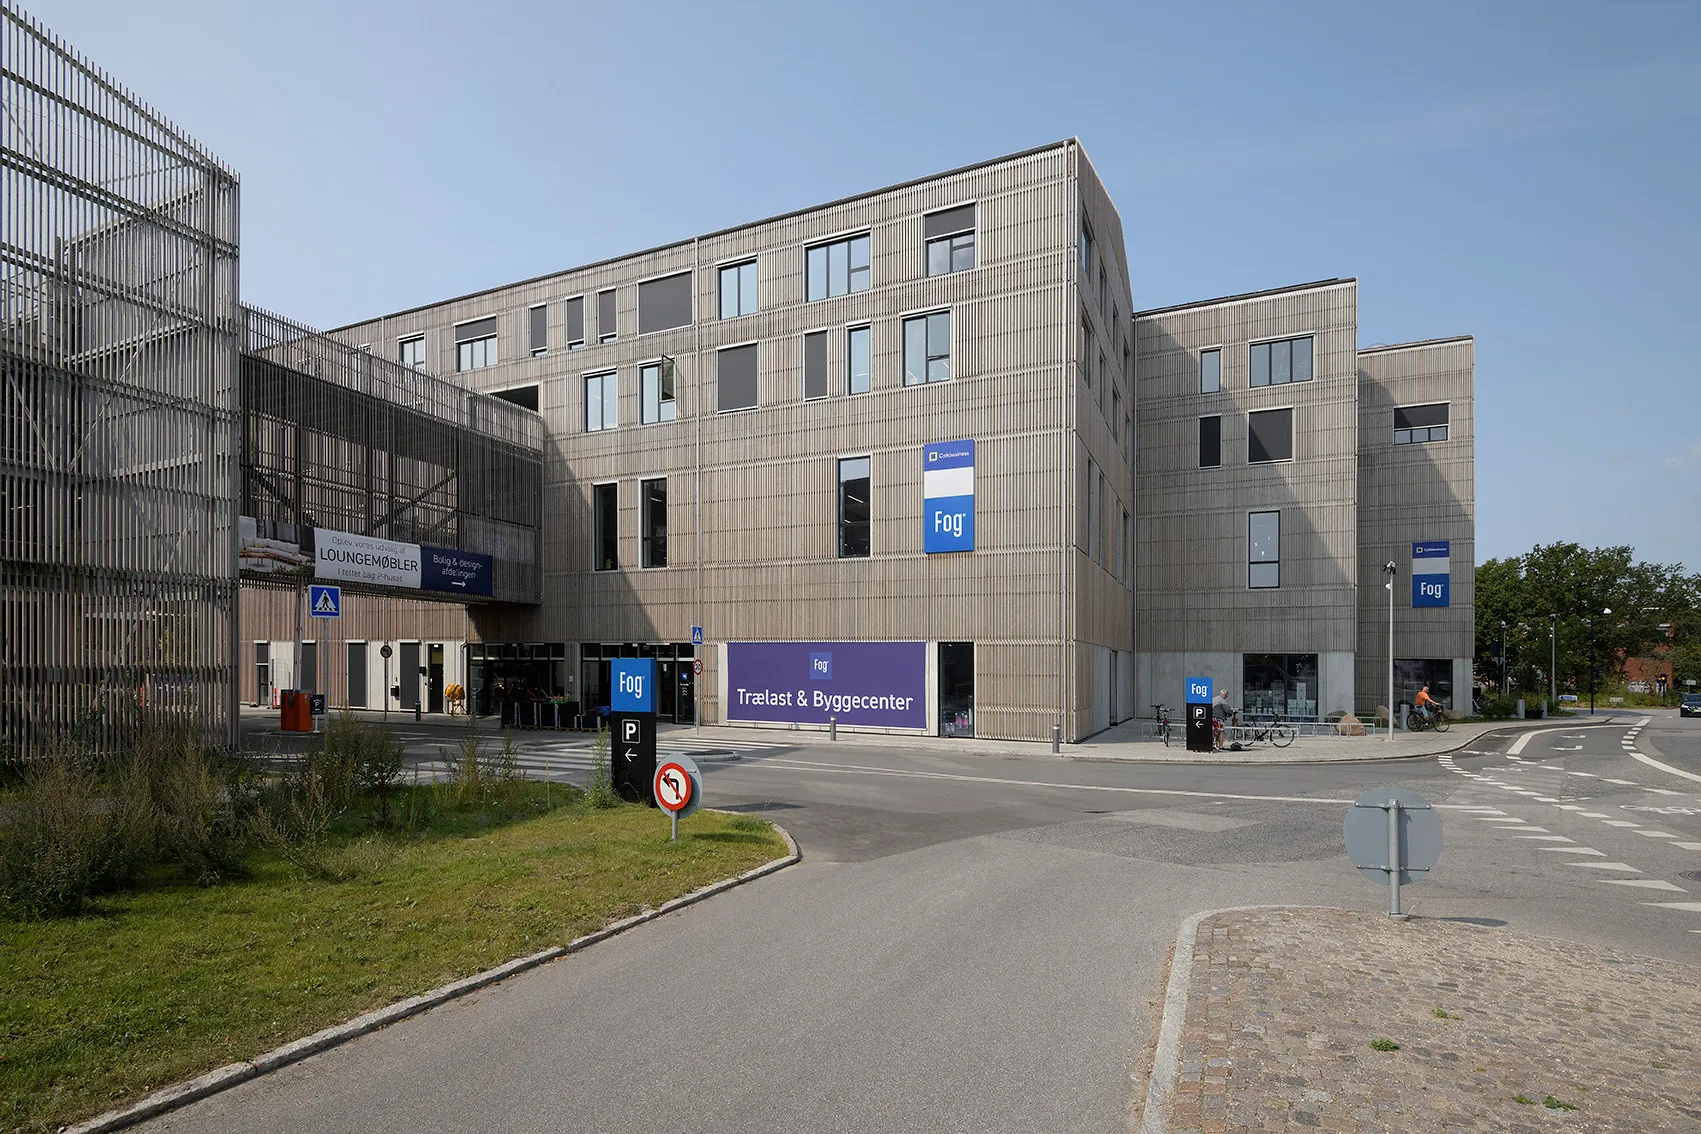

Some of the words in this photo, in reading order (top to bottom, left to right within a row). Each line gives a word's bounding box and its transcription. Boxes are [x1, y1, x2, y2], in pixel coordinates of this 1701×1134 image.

[935, 511, 963, 537] Fog
[354, 542, 374, 550] vores
[376, 544, 398, 555] udvalg
[320, 548, 418, 572] LOUNGEMØBLER
[433, 554, 451, 567] Bolig
[452, 558, 458, 566] &
[459, 560, 483, 570] design-
[362, 570, 376, 580] bag
[442, 567, 476, 580] afdelingen
[1420, 582, 1442, 599] Fog
[814, 658, 829, 674] Fog
[620, 672, 643, 699] Fog
[1191, 684, 1207, 698] Fog
[737, 688, 793, 706] Trælast
[796, 690, 808, 707] &
[813, 690, 914, 713] Byggecenter
[1196, 708, 1203, 718] P
[626, 722, 637, 740] P
